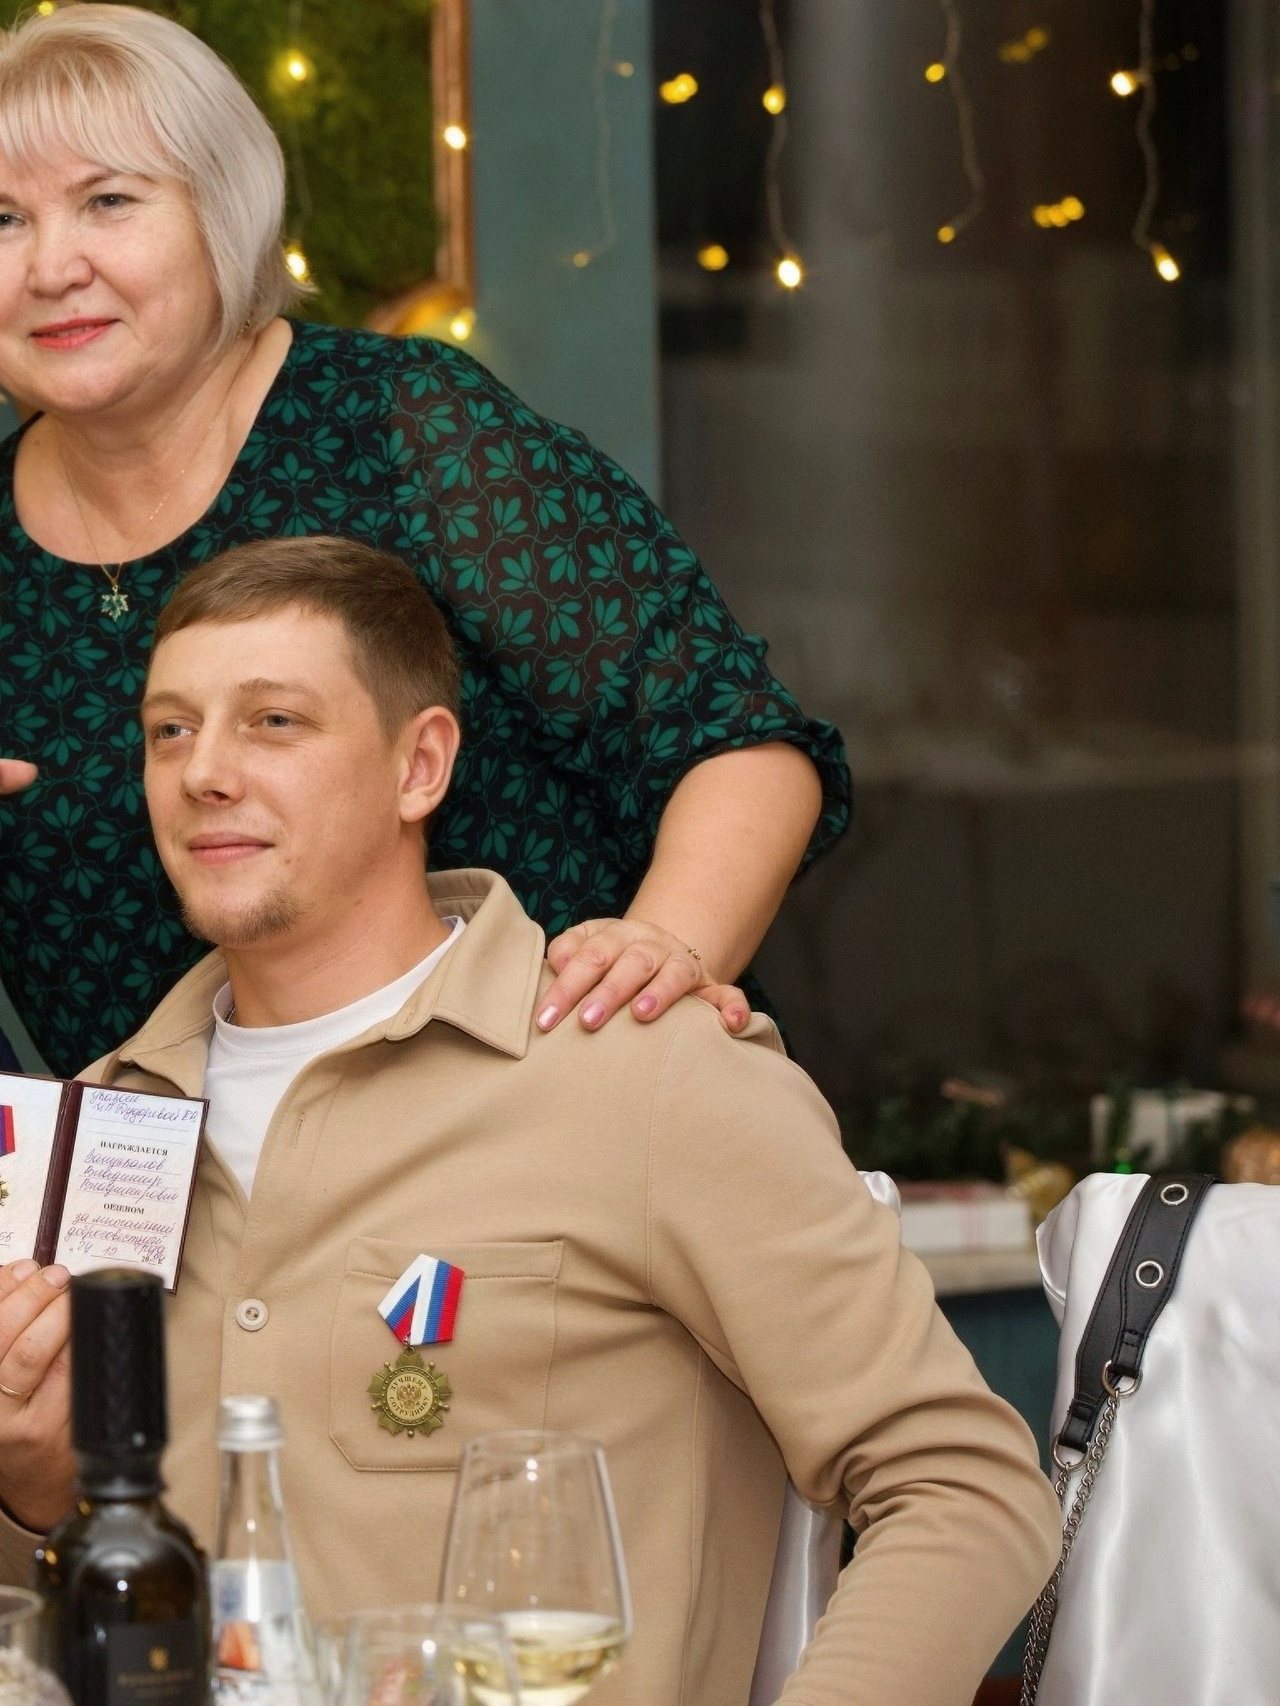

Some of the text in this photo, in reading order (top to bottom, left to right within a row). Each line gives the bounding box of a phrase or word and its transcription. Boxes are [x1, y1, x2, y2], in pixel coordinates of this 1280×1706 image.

[100, 1140, 168, 1156] НАГРАЖДАЕТСЯ
[103, 1202, 145, 1214] ОРДЕНОМ
[72, 1213, 88, 1225] за
[390, 1376, 428, 1391] ЛУЧШЕМУ
[390, 1396, 429, 1416] СОТРУДНИКУ
